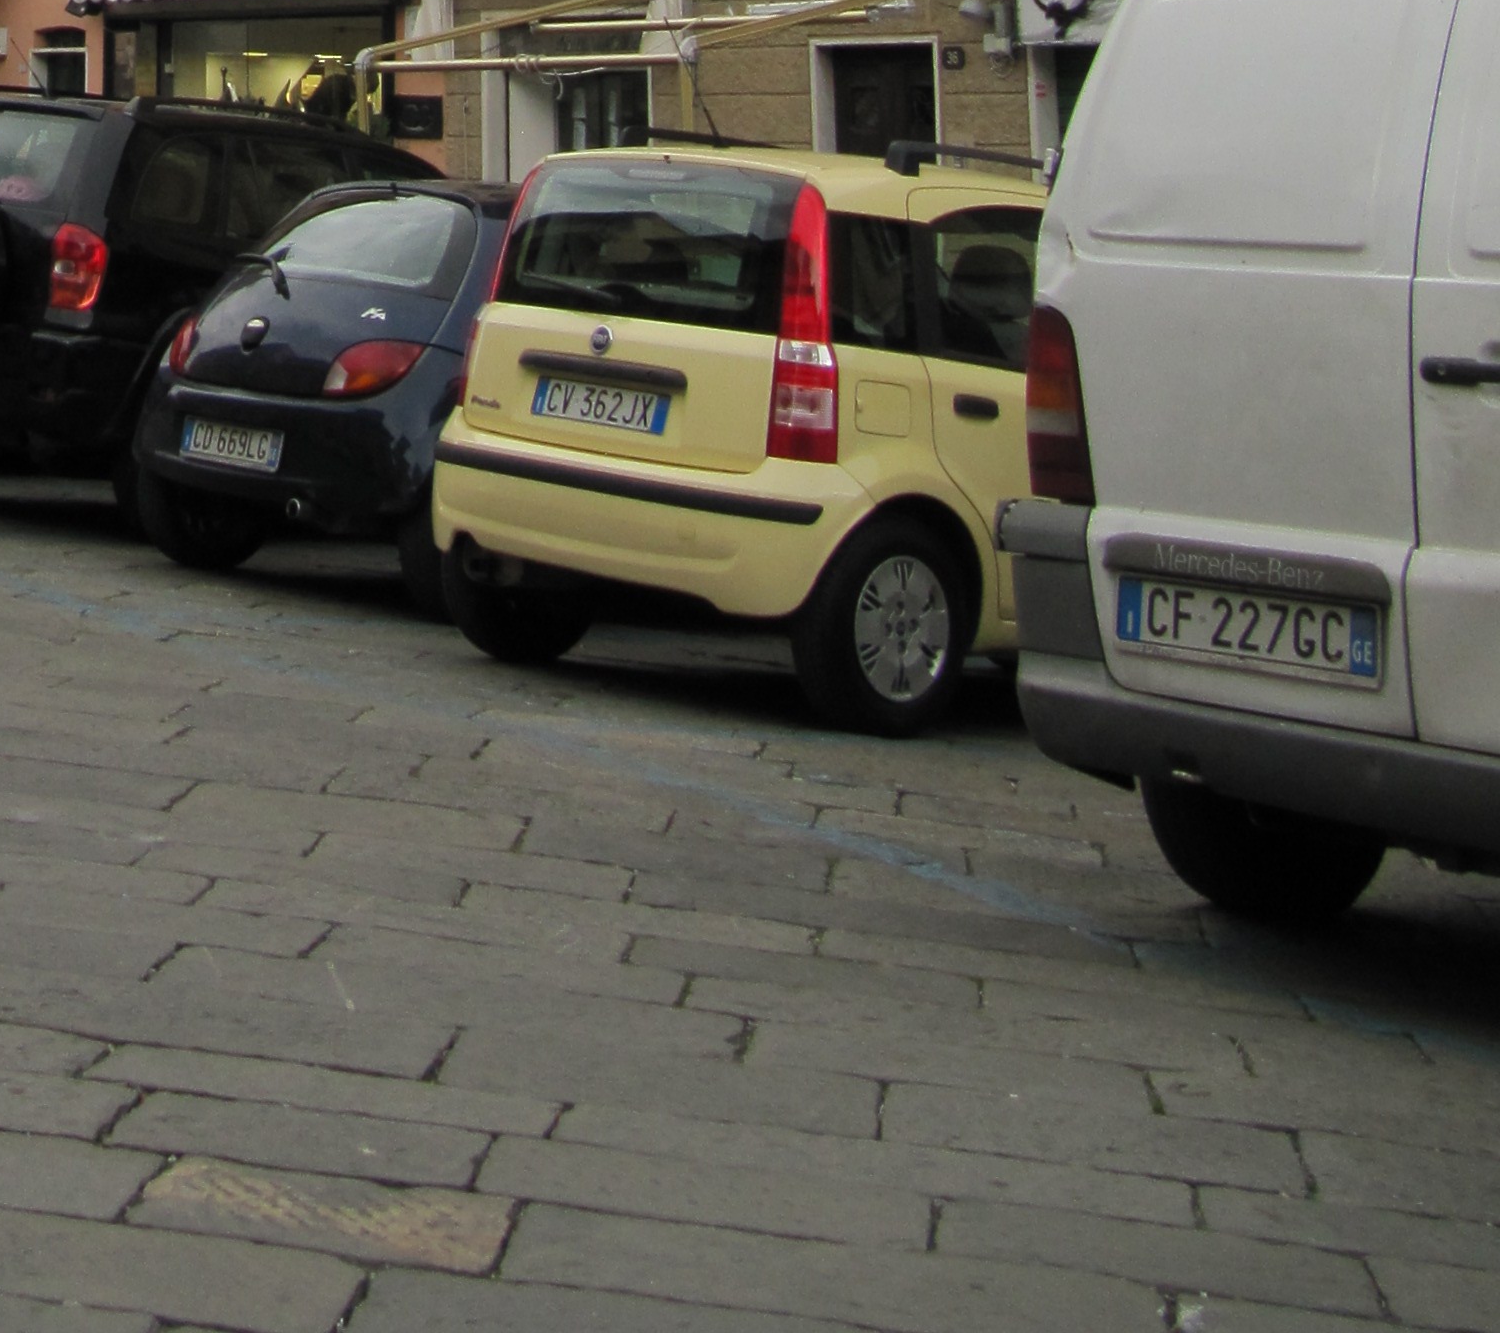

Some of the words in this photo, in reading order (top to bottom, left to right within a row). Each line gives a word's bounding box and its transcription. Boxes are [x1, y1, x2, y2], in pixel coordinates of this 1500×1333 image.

[546, 383, 576, 414] CV
[580, 386, 655, 428] 362JX
[192, 423, 213, 451] CD
[217, 428, 269, 460] 669LG
[1154, 543, 1325, 589] Mercedes-Benz
[1147, 587, 1195, 640] CF
[1210, 597, 1345, 663] 227GC
[1352, 639, 1373, 665] GE
